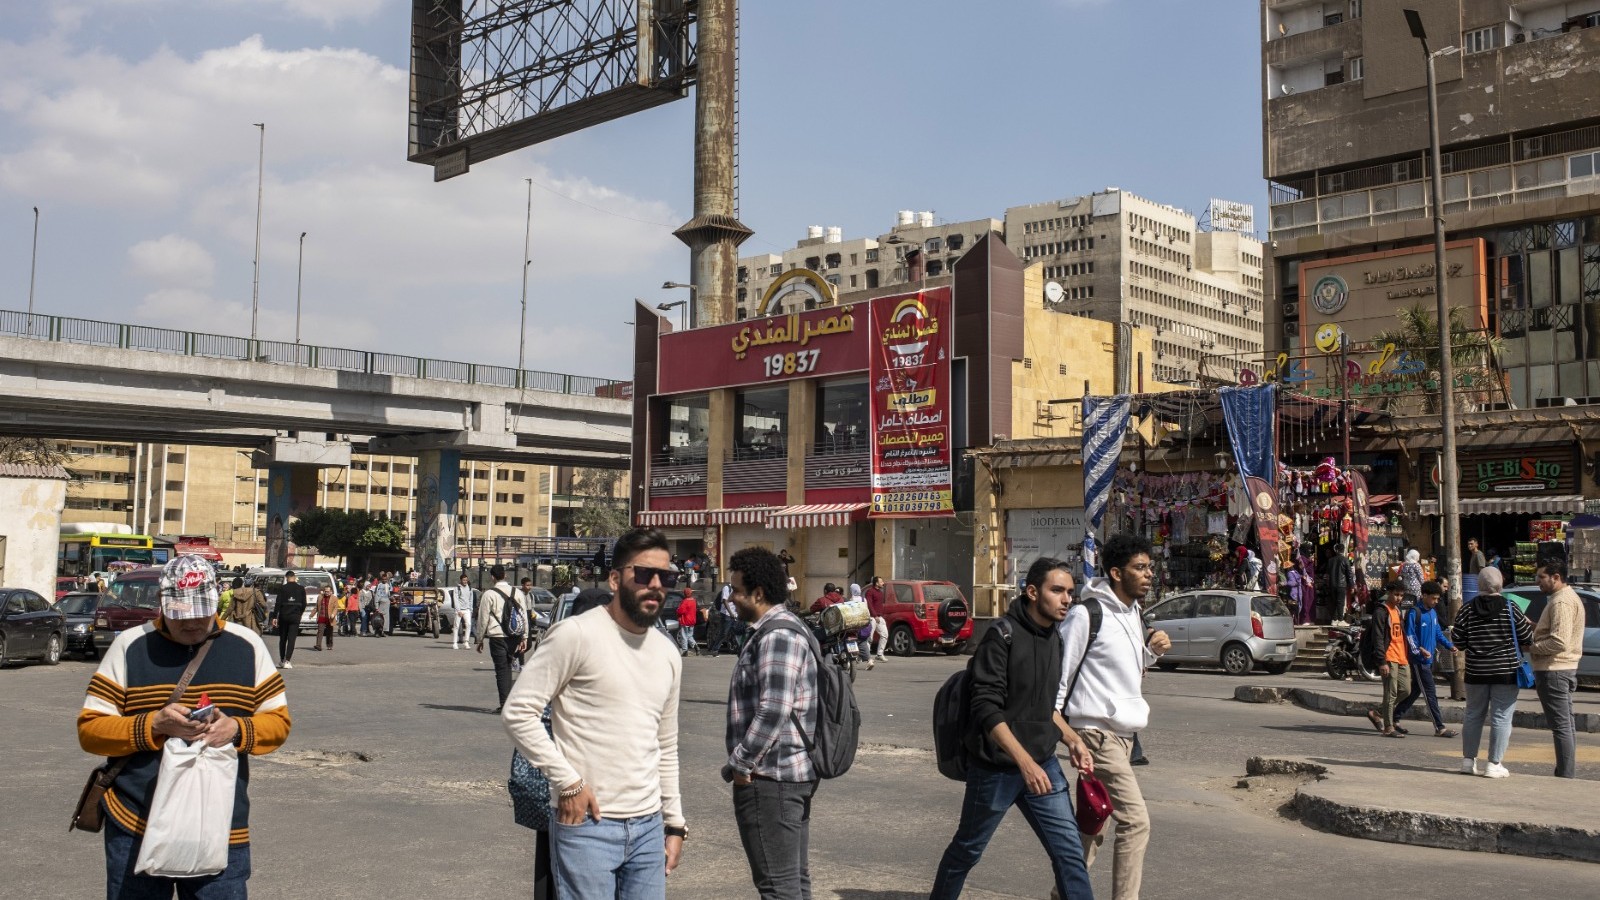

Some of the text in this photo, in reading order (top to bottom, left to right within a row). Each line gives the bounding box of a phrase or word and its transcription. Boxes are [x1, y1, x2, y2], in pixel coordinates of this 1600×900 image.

[731, 305, 854, 360] قصر المندي
[882, 317, 939, 345] قصر المندي
[763, 348, 821, 377] 19837
[892, 354, 925, 367] 19837
[893, 392, 930, 407] مطلوب
[918, 432, 944, 446] جميع
[1030, 518, 1081, 526] BIODERMA
